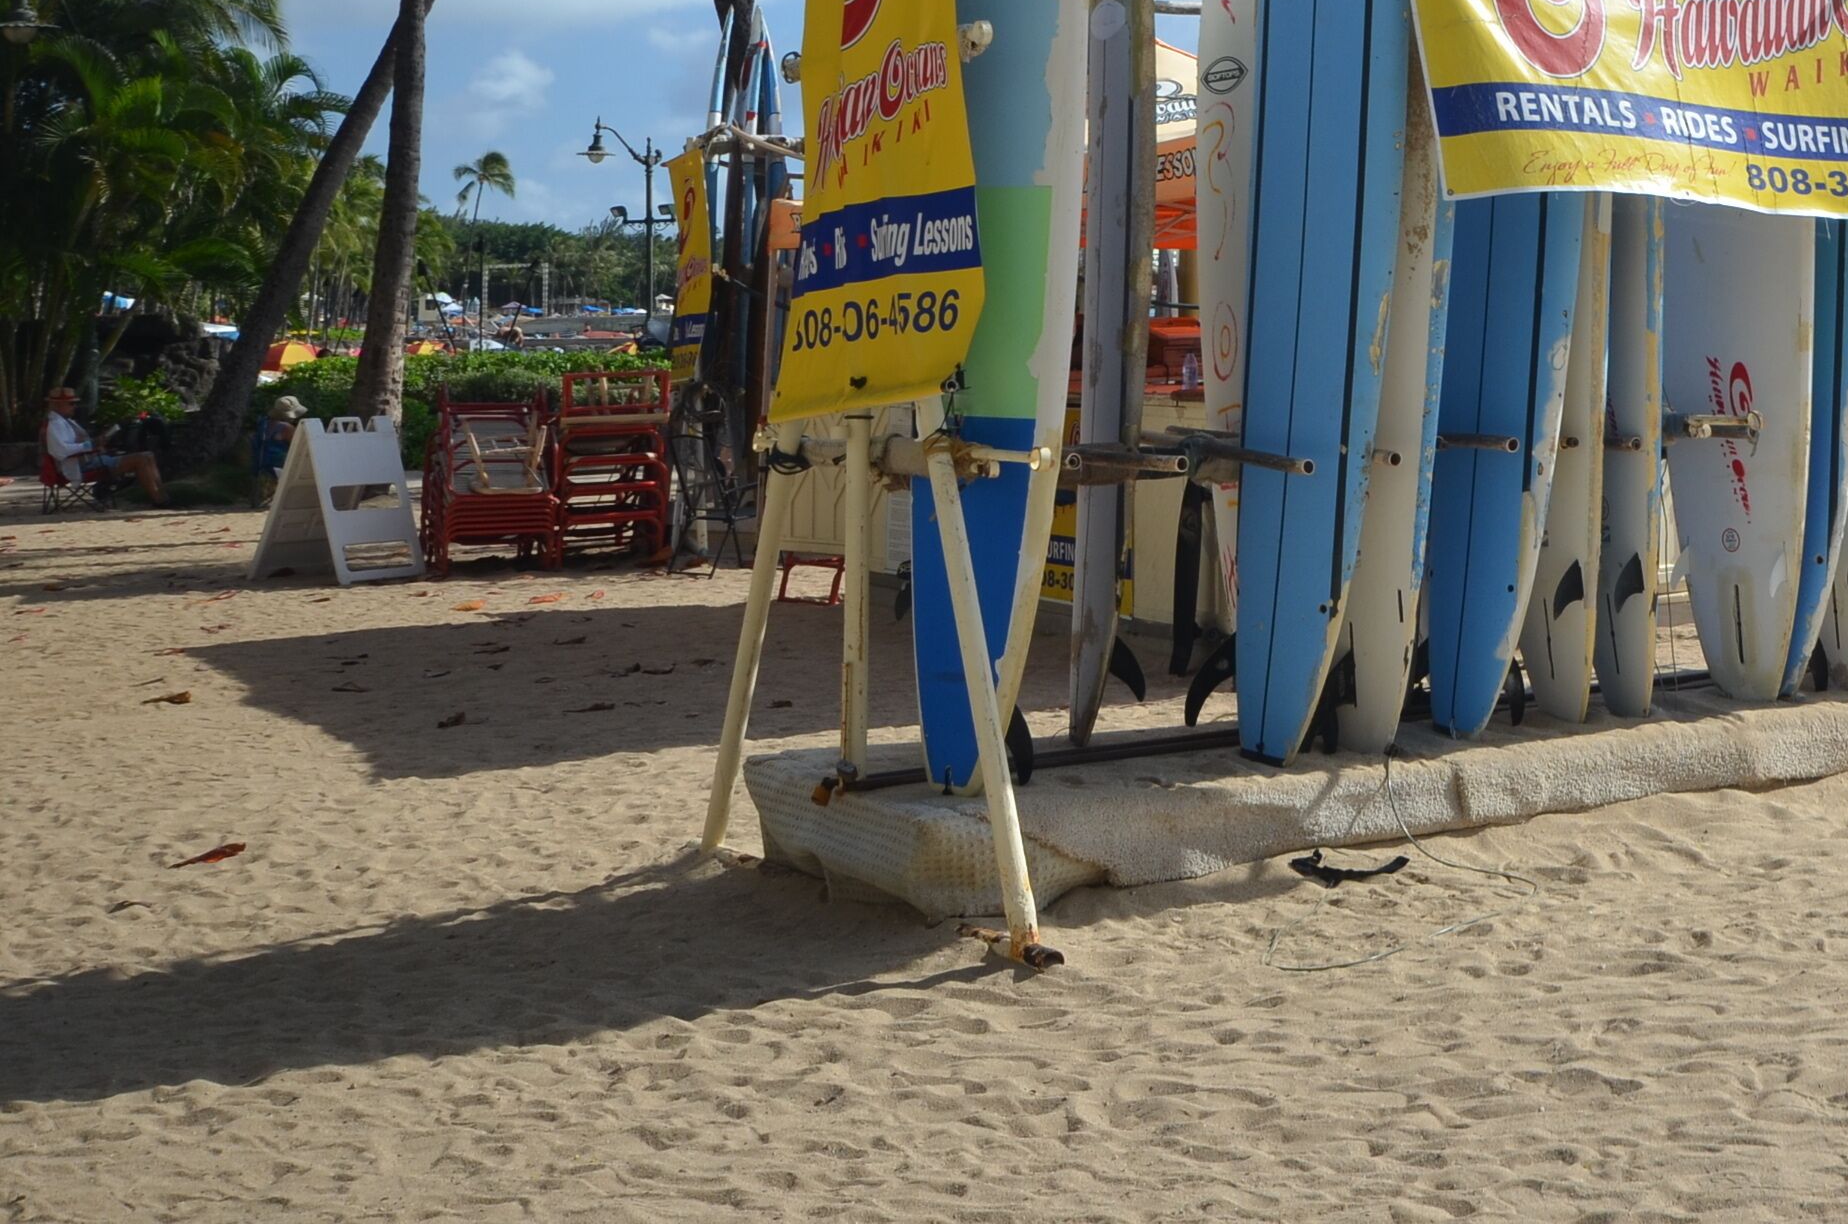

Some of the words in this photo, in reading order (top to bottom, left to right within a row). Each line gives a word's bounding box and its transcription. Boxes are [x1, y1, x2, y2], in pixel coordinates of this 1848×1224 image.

[1497, 91, 1637, 130] RENTALS
[1660, 107, 1738, 144] RIDES
[1523, 151, 1582, 185] Enjoy
[1585, 162, 1597, 171] a
[1597, 148, 1640, 172] Full
[1645, 152, 1680, 176] Day
[1683, 158, 1697, 183] of
[913, 212, 973, 256] Lessons
